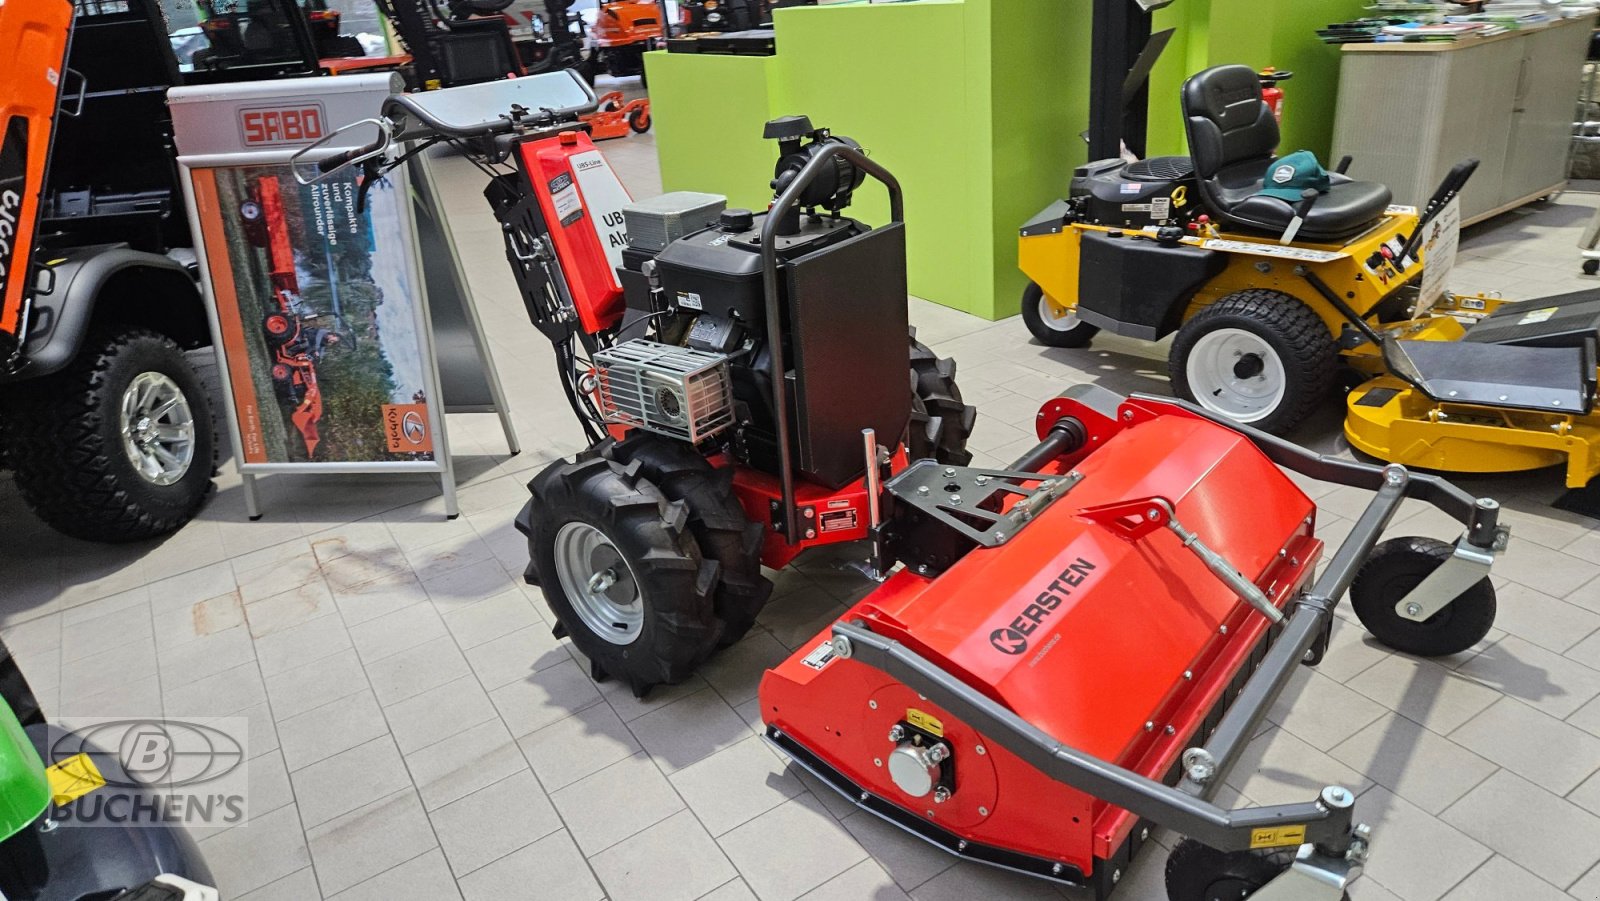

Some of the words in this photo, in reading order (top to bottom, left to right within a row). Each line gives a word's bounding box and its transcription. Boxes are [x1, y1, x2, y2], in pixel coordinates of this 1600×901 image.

[244, 109, 322, 142] SABO
[576, 160, 602, 170] UBS-Line
[310, 184, 325, 236] Allrounder
[331, 182, 343, 202] und
[343, 182, 358, 234] Kompakte
[320, 183, 338, 246] zuverlässige
[602, 211, 624, 227] UB
[388, 408, 401, 448] Kubota
[990, 557, 1097, 656] KERSTEN
